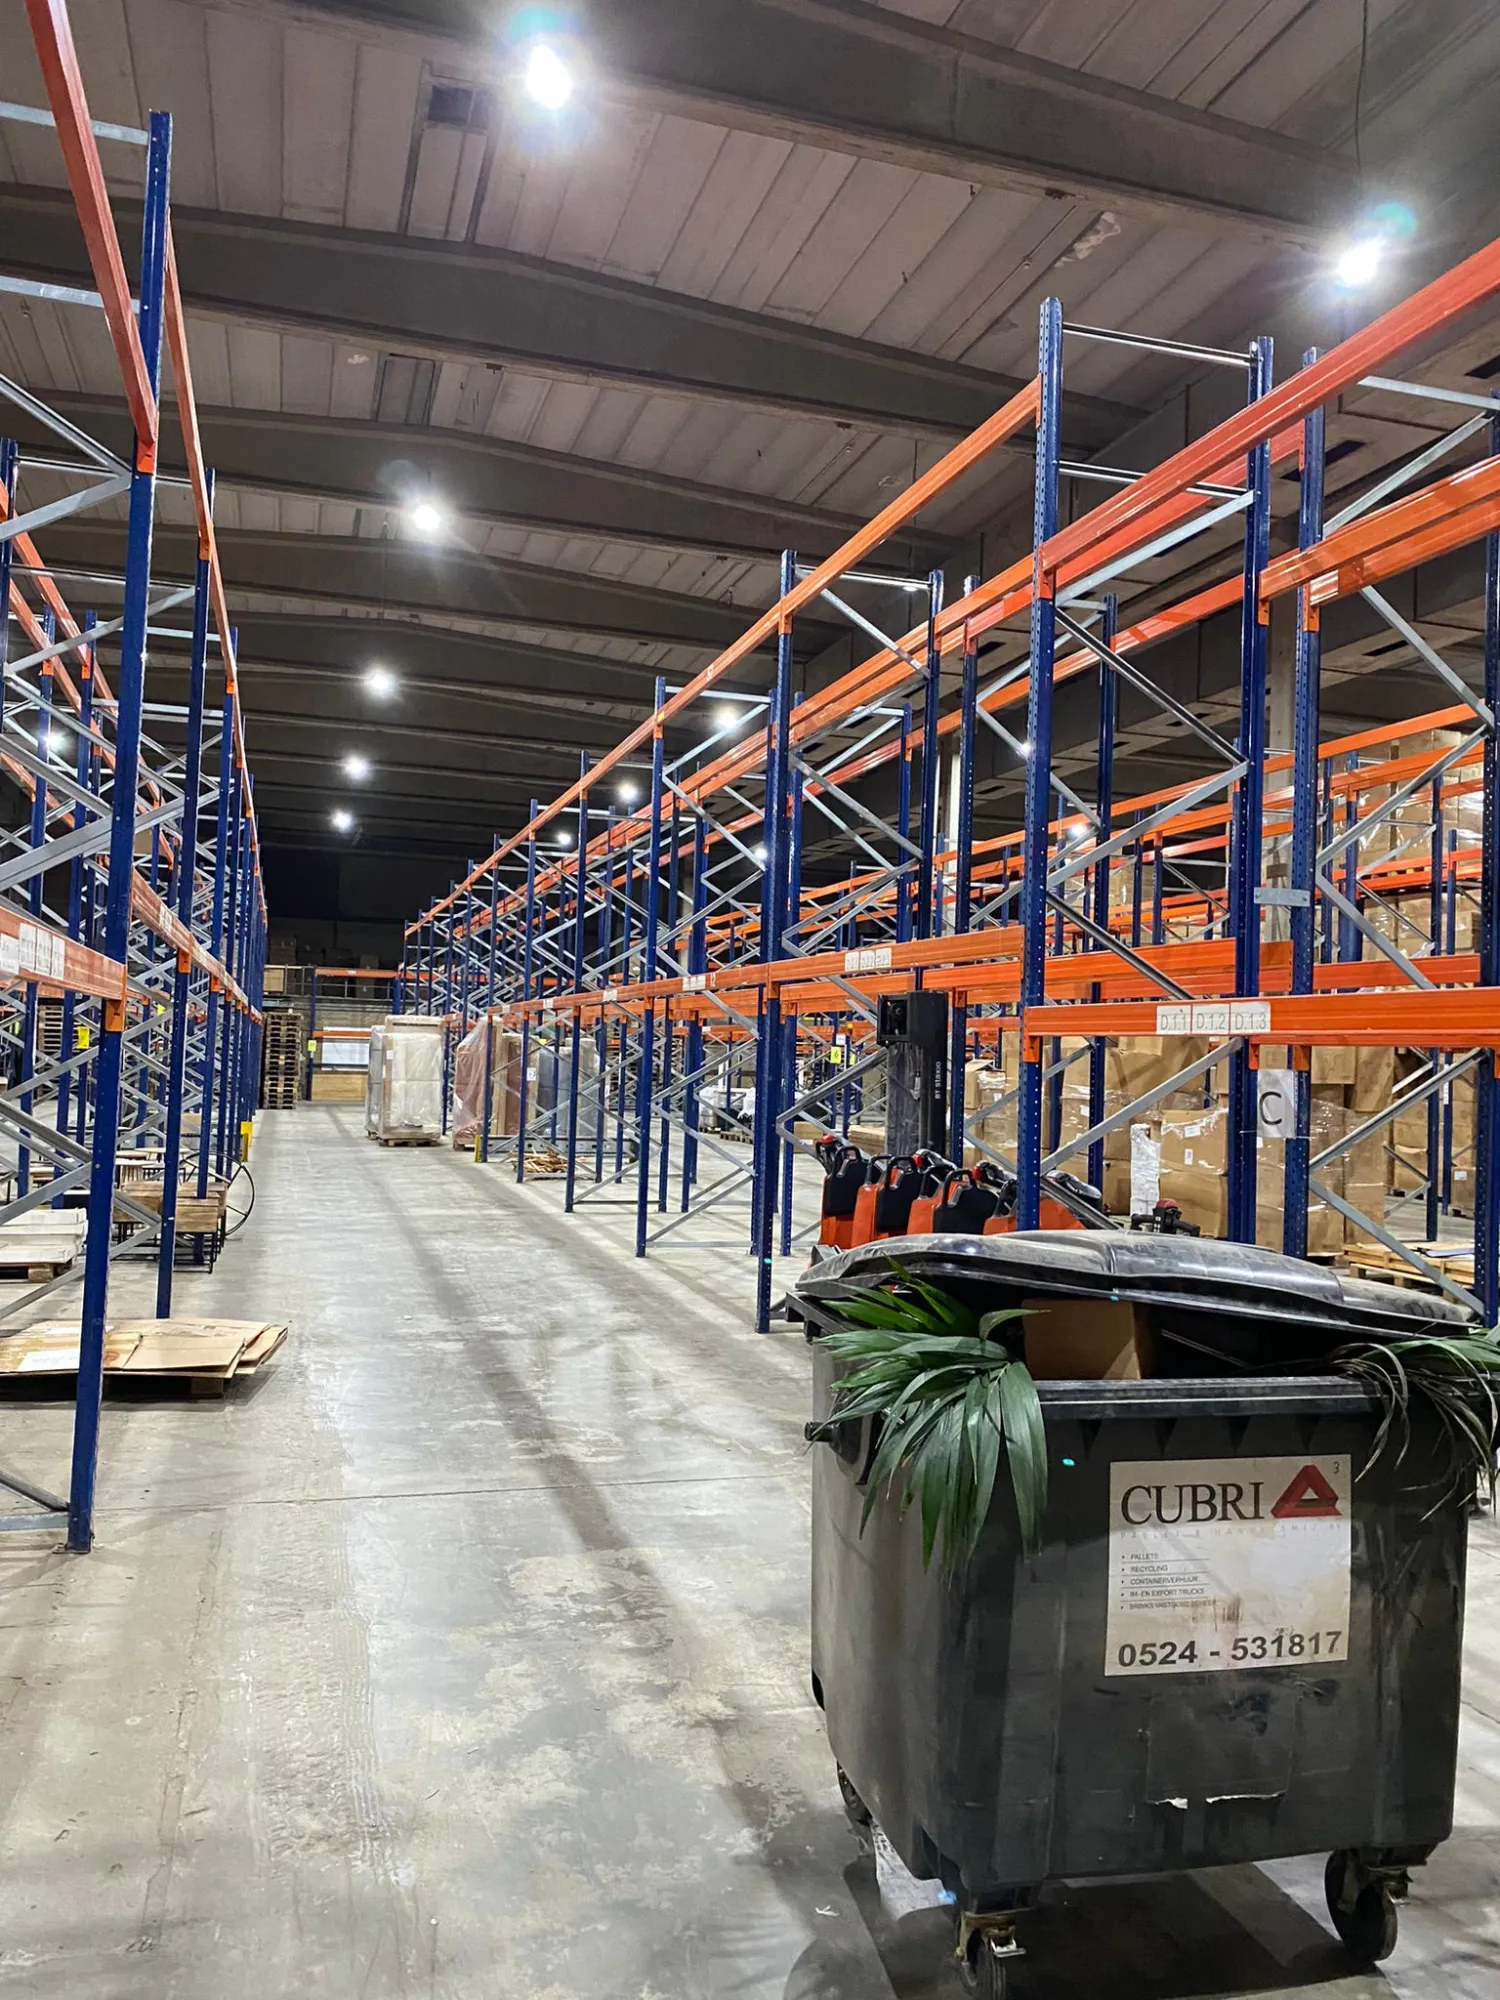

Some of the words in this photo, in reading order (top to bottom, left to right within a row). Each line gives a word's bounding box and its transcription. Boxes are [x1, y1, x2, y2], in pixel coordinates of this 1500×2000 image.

[1196, 1012, 1226, 1030] D.1.2
[1234, 1012, 1267, 1031] D.1.3
[1259, 1091, 1282, 1126] C
[1332, 1461, 1340, 1474] 3
[1121, 1482, 1265, 1525] CUBRI
[1130, 1552, 1158, 1560] PALLETS
[1130, 1564, 1168, 1573] RECYCLING
[1151, 1588, 1177, 1597] EXPORT
[1118, 1639, 1198, 1667] 0524
[1230, 1630, 1342, 1661] 531817
